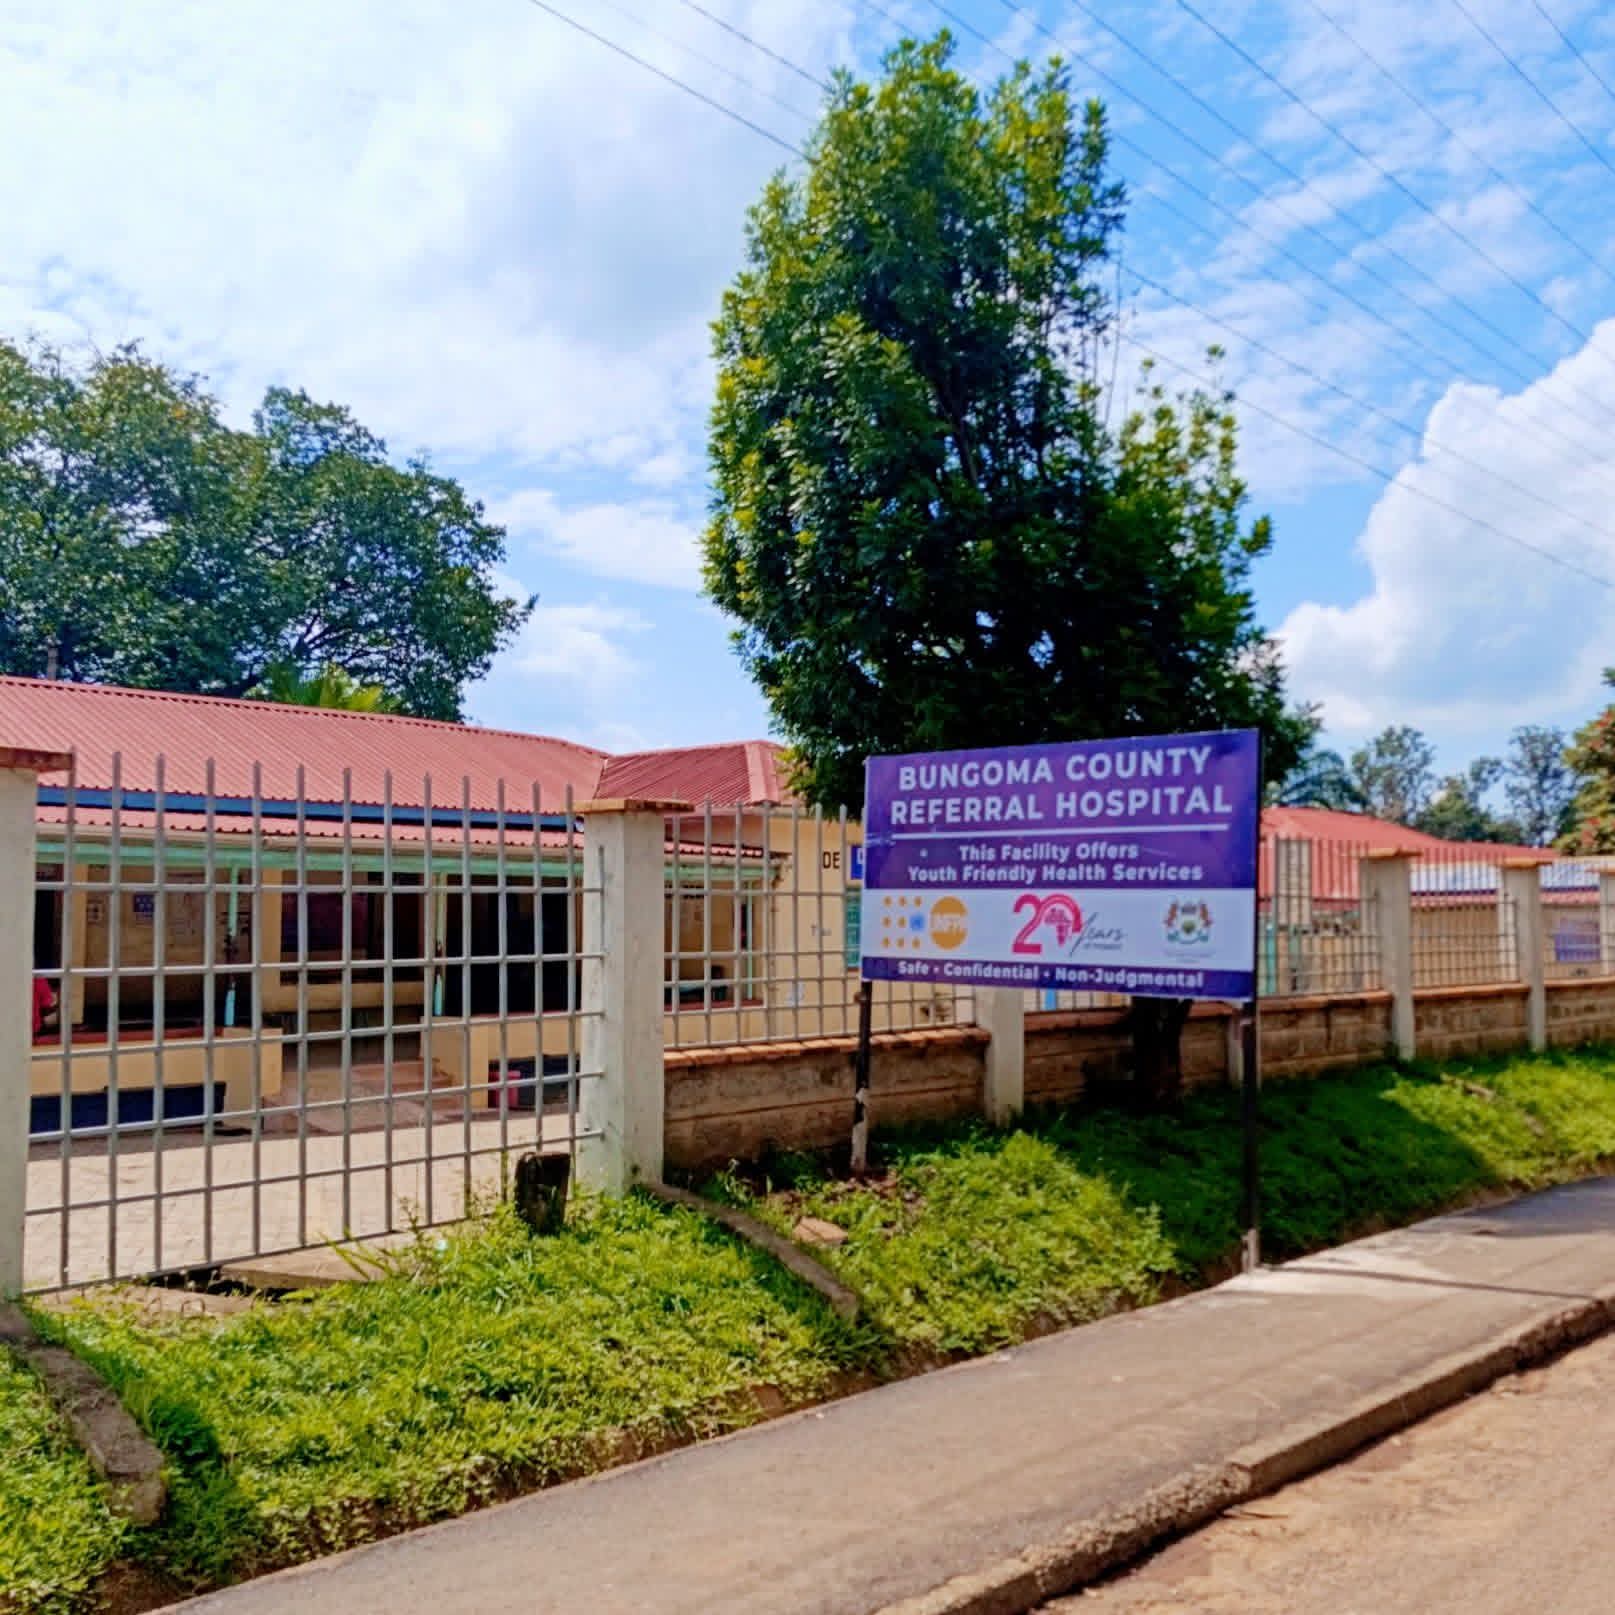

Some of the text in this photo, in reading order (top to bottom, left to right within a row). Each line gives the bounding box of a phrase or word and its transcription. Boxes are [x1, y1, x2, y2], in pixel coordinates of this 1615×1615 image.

[899, 746, 1212, 791] BUNGOMA COUNTY
[890, 785, 1232, 825] REFERRAL HOSPITAL
[960, 843, 1139, 862] This Facility Offers
[908, 863, 1203, 884] Youth Friendly Health Services
[898, 962, 1204, 989] Safe Confidential Non-Judgmental
